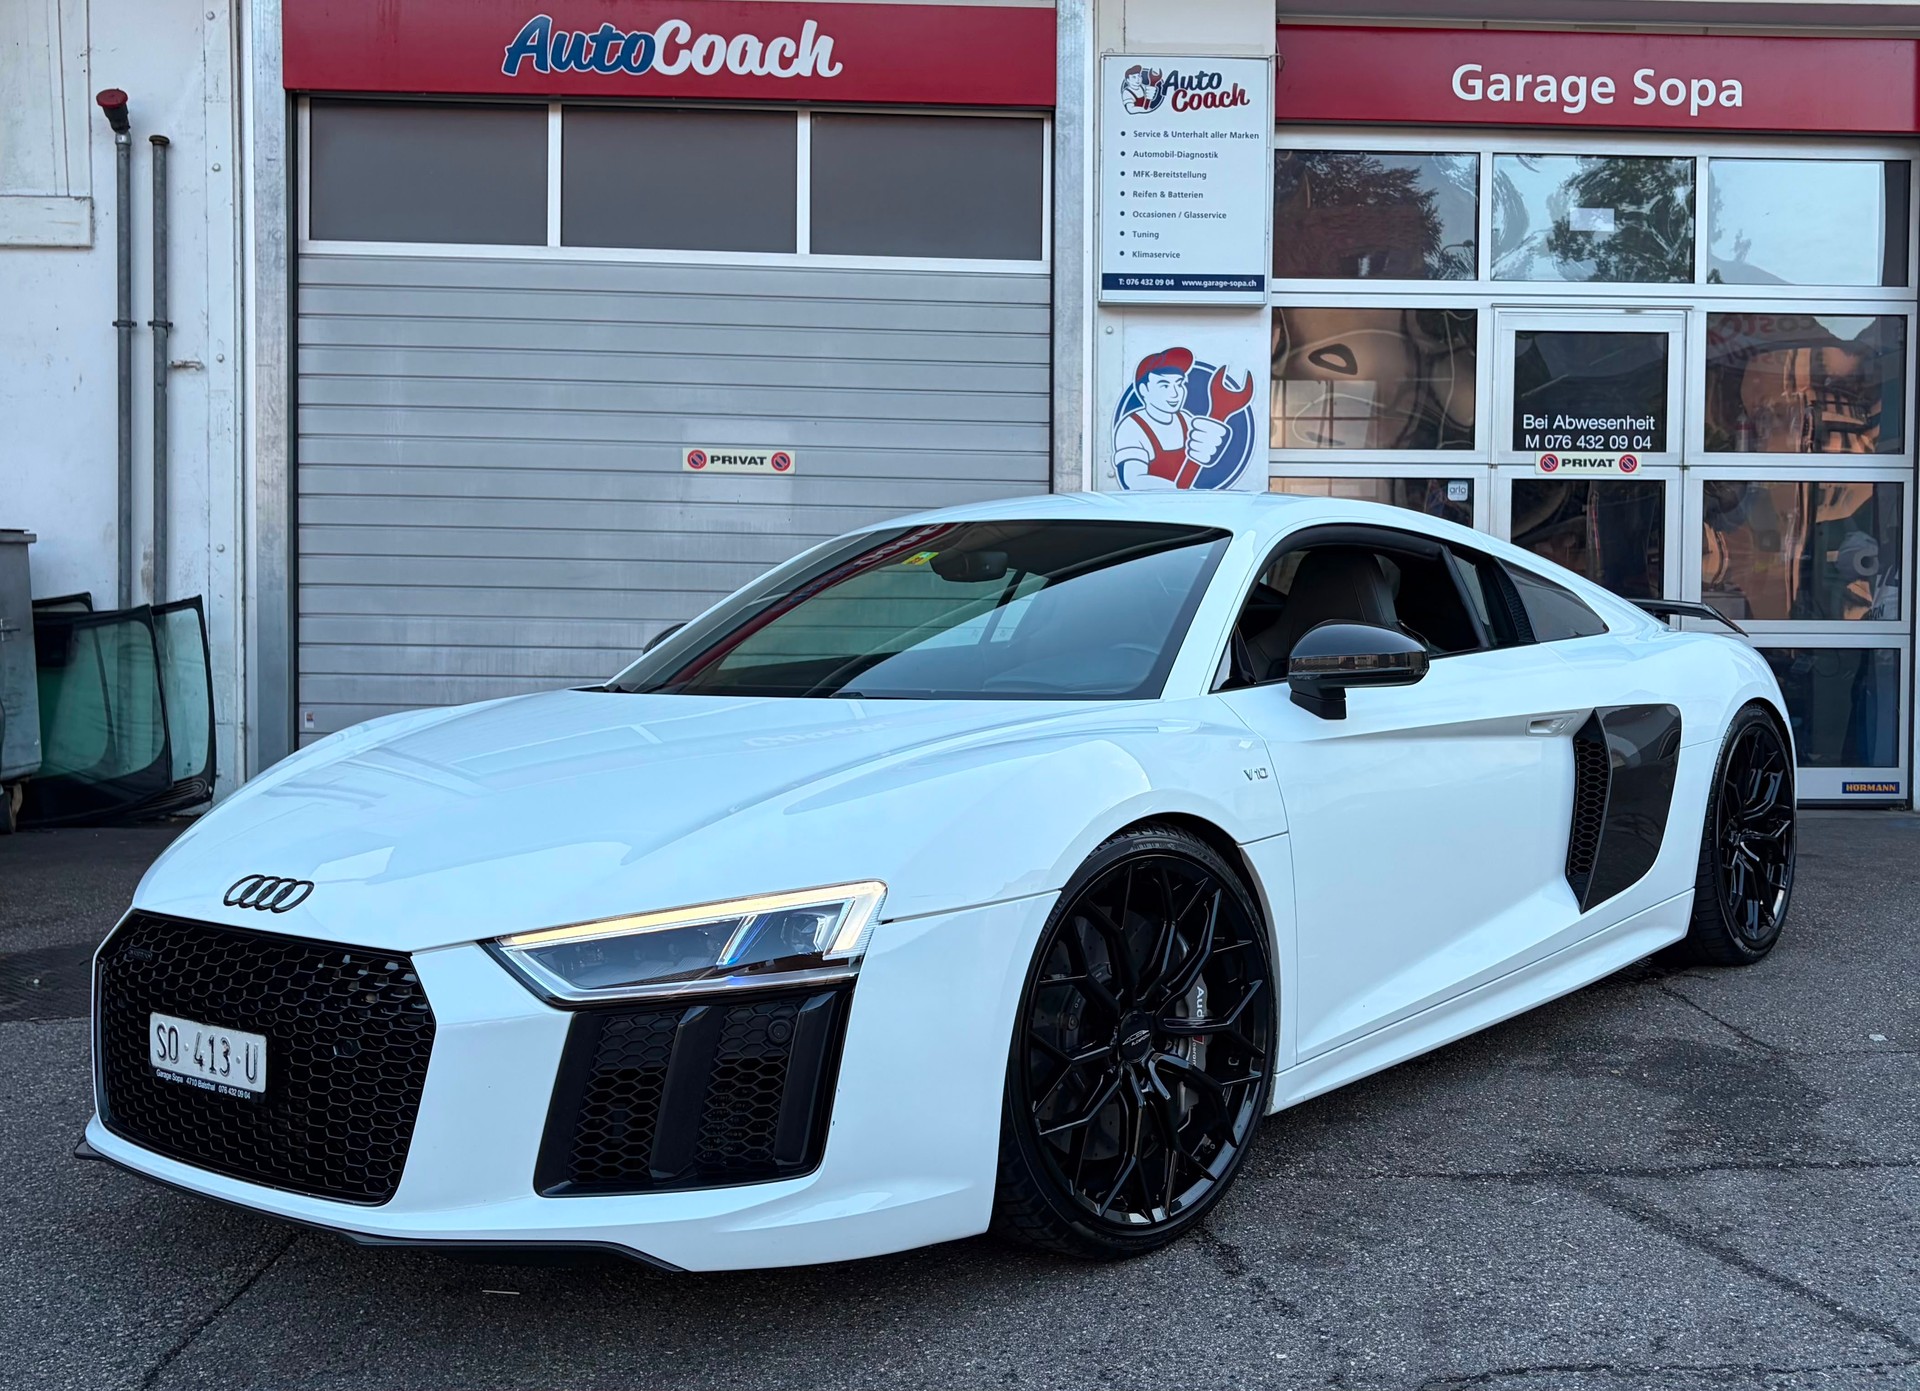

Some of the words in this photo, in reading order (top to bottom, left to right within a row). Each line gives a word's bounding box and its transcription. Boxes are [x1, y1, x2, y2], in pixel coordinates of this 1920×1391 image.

[1161, 70, 1223, 96] Auto
[1452, 64, 1615, 113] Garage
[1634, 69, 1742, 116] Sopa
[1171, 83, 1251, 113] Coach
[1172, 131, 1209, 139] Unterhalt
[1211, 131, 1228, 139] aller
[1230, 132, 1260, 140] Marken
[1133, 151, 1219, 161] Automobil-Diagnostik
[1133, 171, 1207, 181] MFK-Bereitstellung
[1168, 191, 1204, 199] Batterien
[1133, 211, 1177, 219] Occasionen
[1184, 212, 1227, 220] Glasservice
[1133, 231, 1160, 241] Tuning
[1132, 251, 1181, 259] Klimaservice
[1182, 280, 1257, 289] www.garage-sopa.ch
[1524, 414, 1547, 429] Bei
[1553, 415, 1655, 430] Abwesenheit
[1526, 435, 1539, 448] M
[1545, 435, 1571, 448] 076
[1577, 435, 1604, 449] 432
[1610, 435, 1628, 449] 09
[1633, 436, 1651, 449] 04
[710, 455, 767, 466] PRIVAT
[1561, 458, 1615, 468] PRIVAT
[1243, 767, 1268, 781] V10
[157, 1022, 179, 1063] SO
[194, 1031, 231, 1077] 413
[245, 1042, 258, 1083] U
[156, 1069, 172, 1081] Garage
